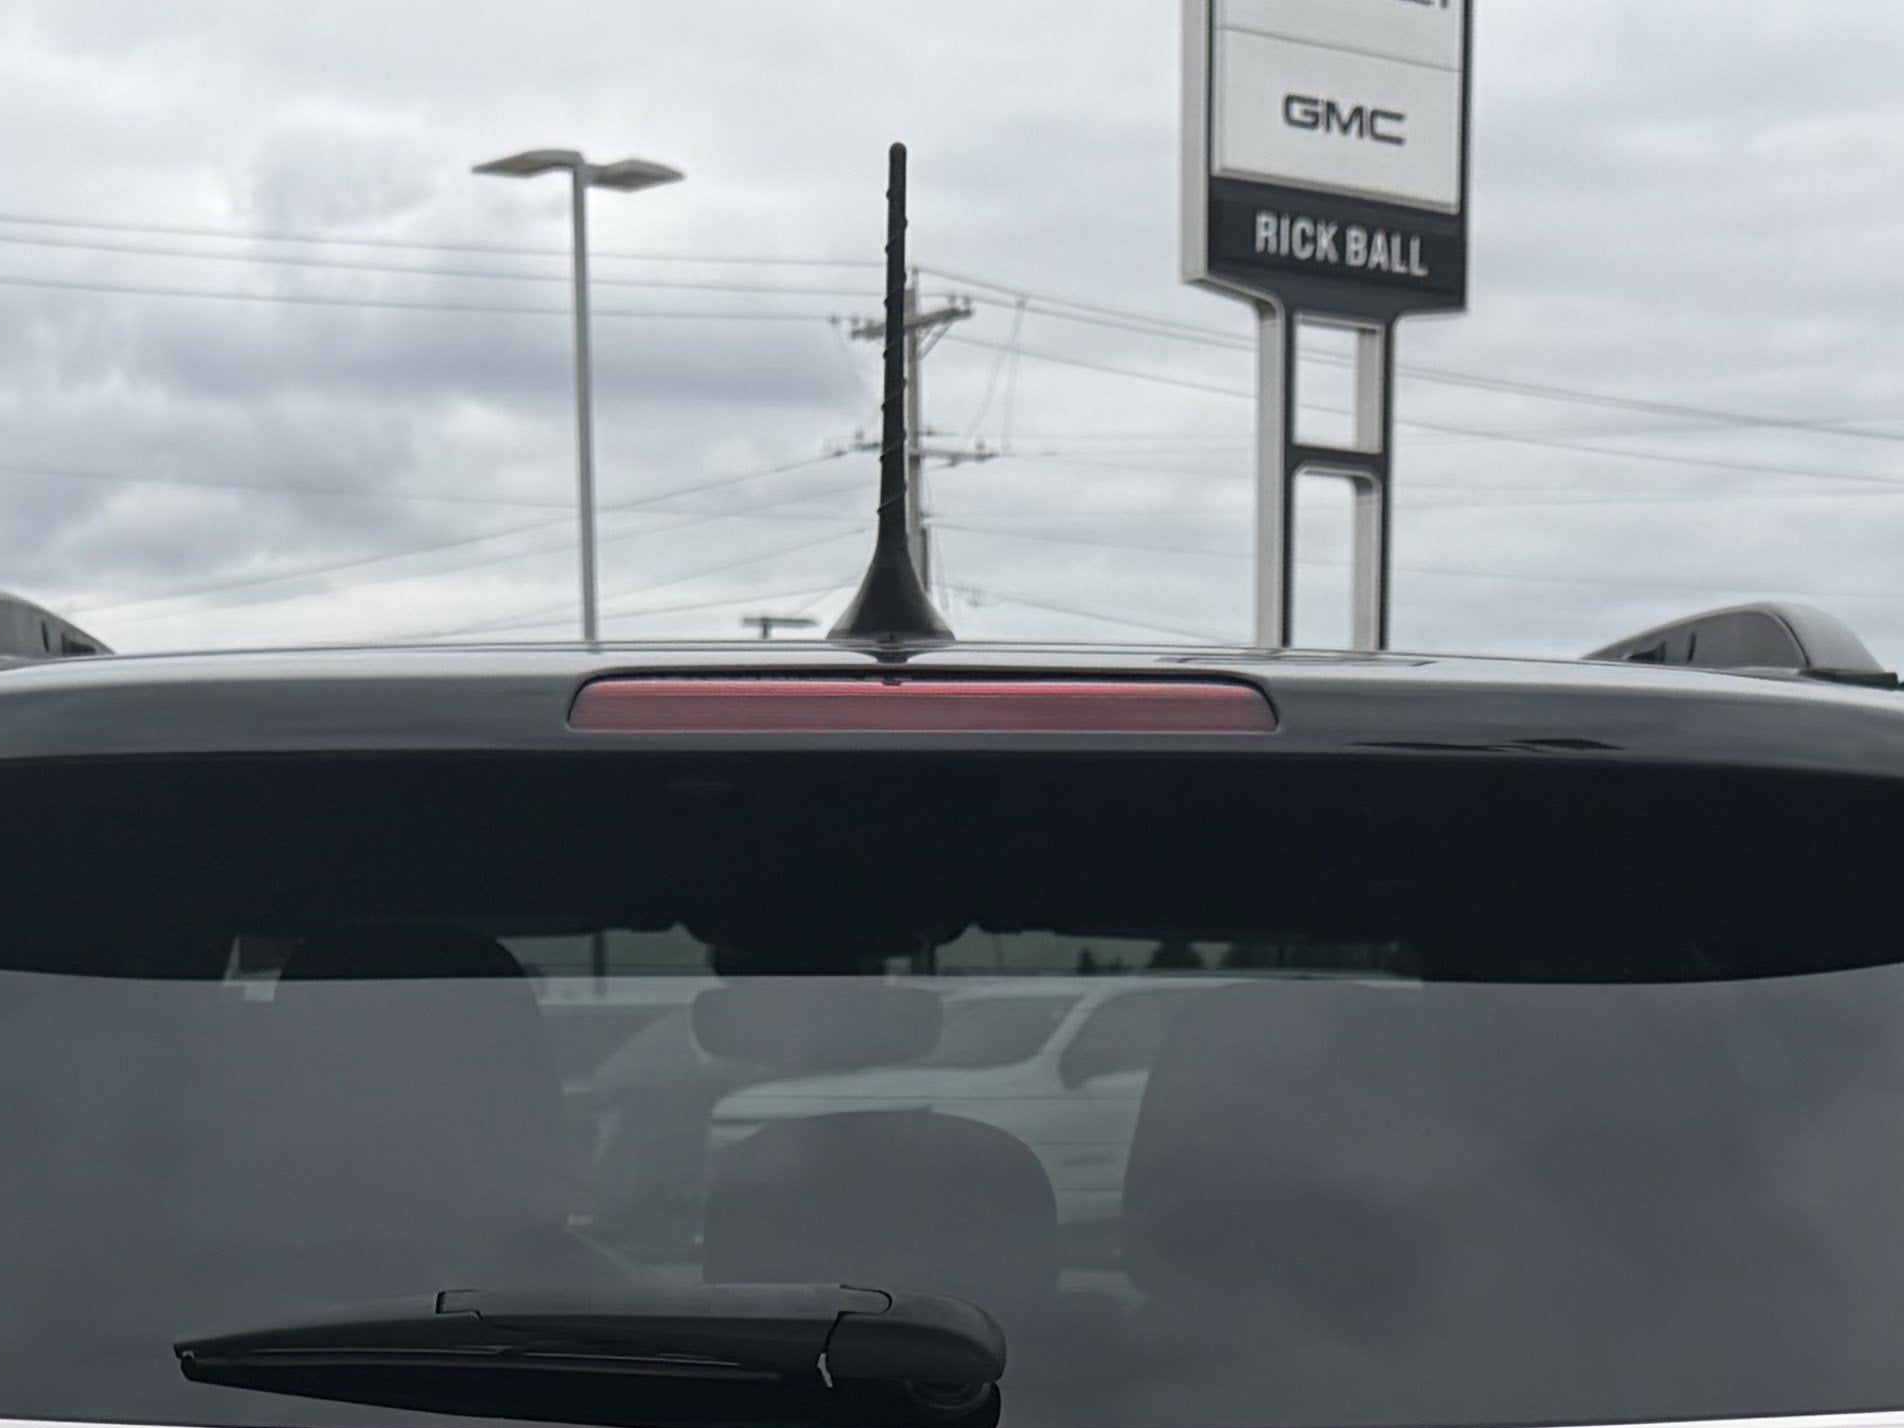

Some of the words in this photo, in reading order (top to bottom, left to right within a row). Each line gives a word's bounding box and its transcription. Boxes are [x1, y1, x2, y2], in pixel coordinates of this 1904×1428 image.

[1282, 93, 1406, 146] GMC
[1254, 210, 1339, 264] RICK
[1345, 223, 1429, 278] BALL
